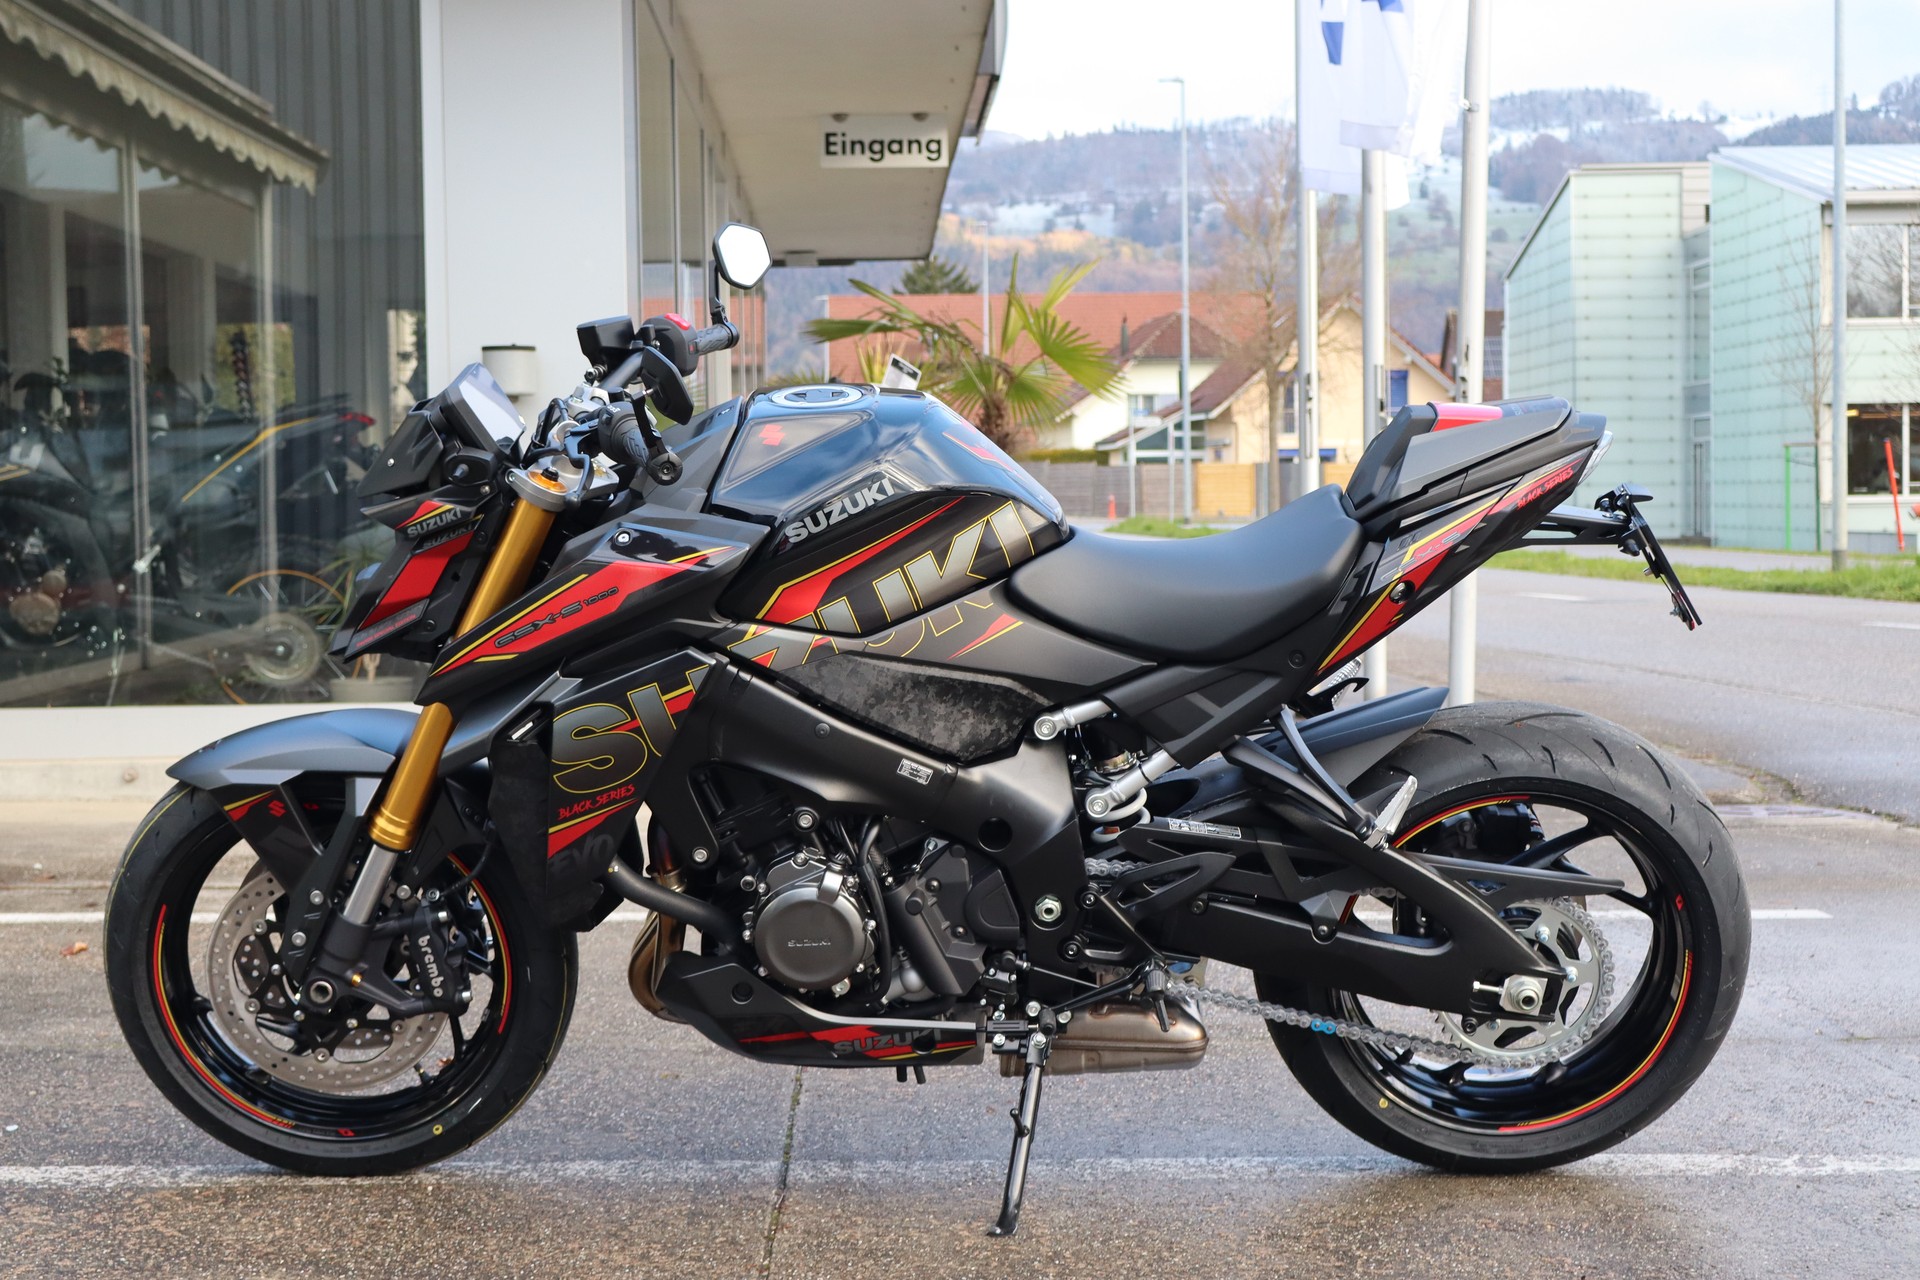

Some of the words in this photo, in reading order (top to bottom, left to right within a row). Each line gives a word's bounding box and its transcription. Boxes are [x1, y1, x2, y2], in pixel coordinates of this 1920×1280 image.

[824, 132, 942, 162] Eingang
[1516, 487, 1544, 510] BLACK
[1541, 467, 1574, 493] SERIES
[407, 507, 462, 538] SUZUKI
[785, 478, 895, 543] SUZUKI
[494, 601, 583, 649] GSX-S
[583, 586, 619, 606] 1000
[557, 799, 597, 820] BLACK
[594, 783, 636, 808] SERIES
[418, 935, 444, 998] brembo
